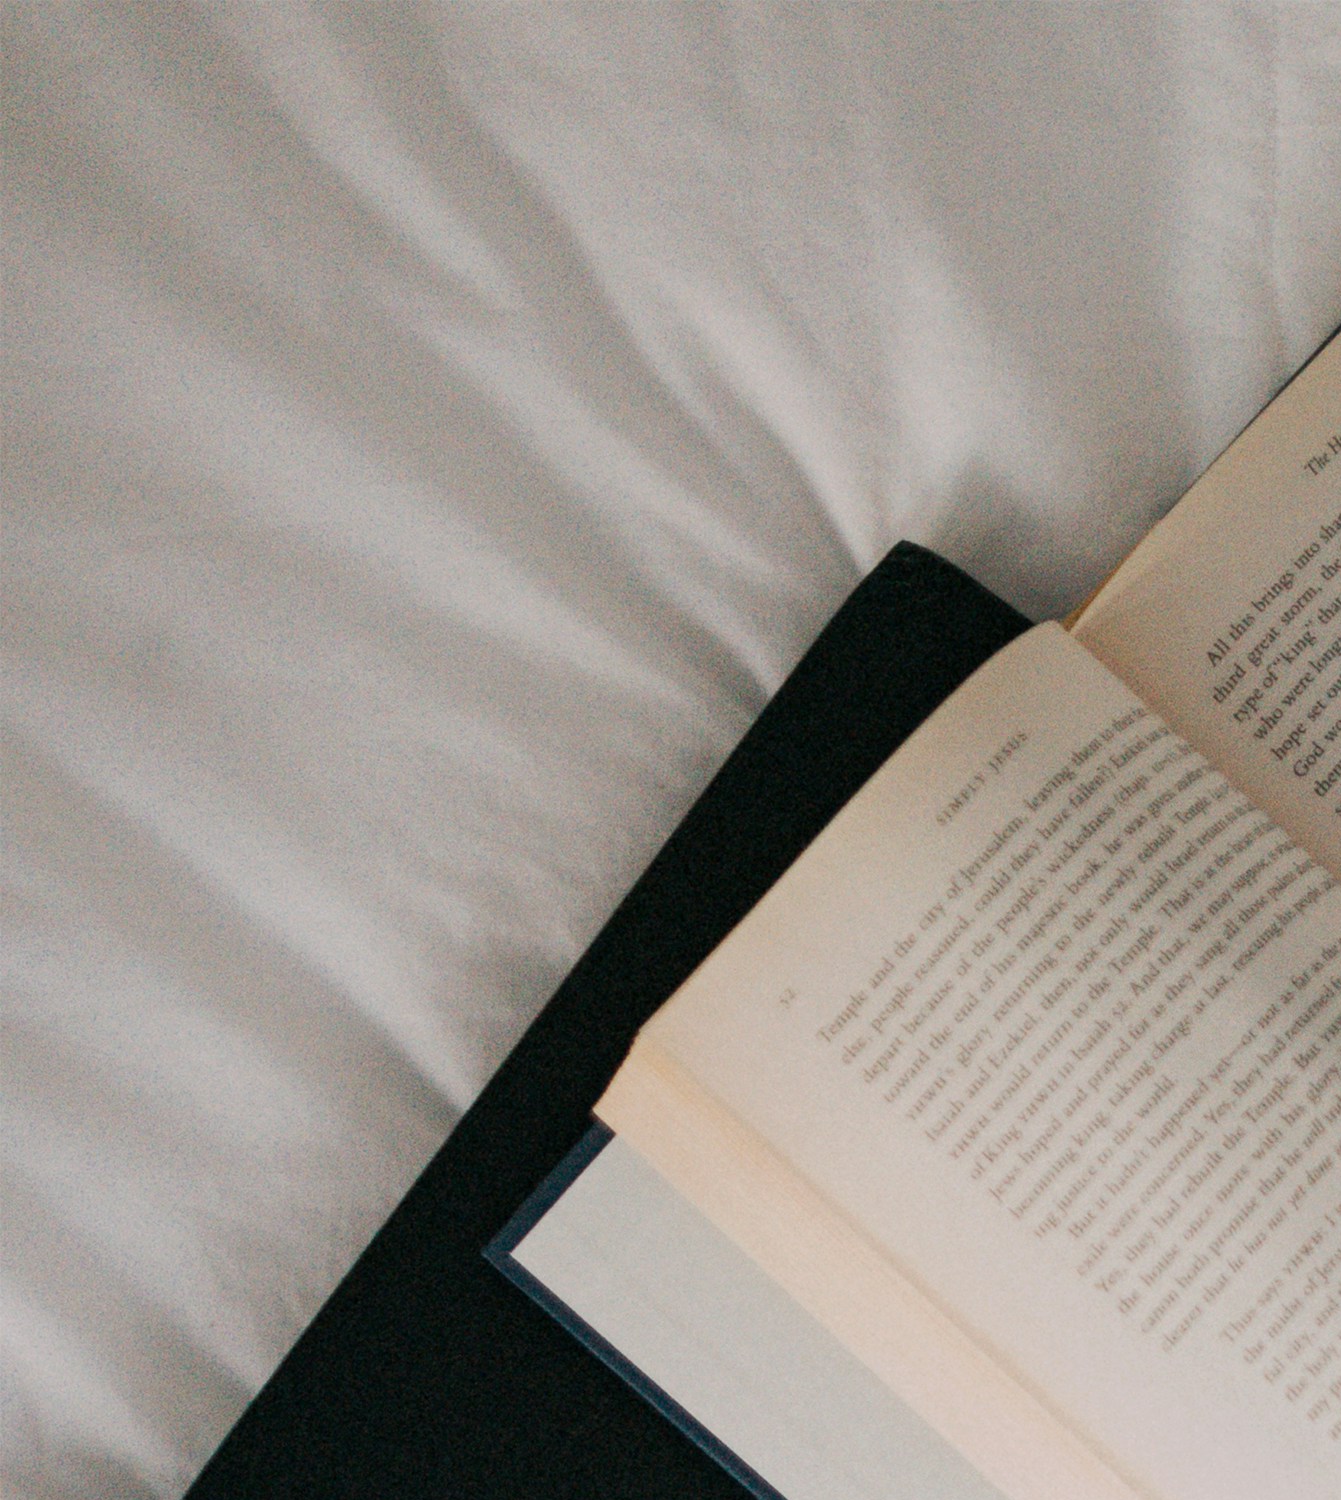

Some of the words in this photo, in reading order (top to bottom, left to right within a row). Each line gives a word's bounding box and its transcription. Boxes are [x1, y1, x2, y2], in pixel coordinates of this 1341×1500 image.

[1304, 452, 1331, 476] The
[1206, 638, 1231, 668] All
[1227, 613, 1256, 642] this
[1250, 570, 1296, 613] brings
[1292, 541, 1321, 571] into
[937, 773, 986, 823] SIMPLY
[988, 732, 1028, 772] JESUS
